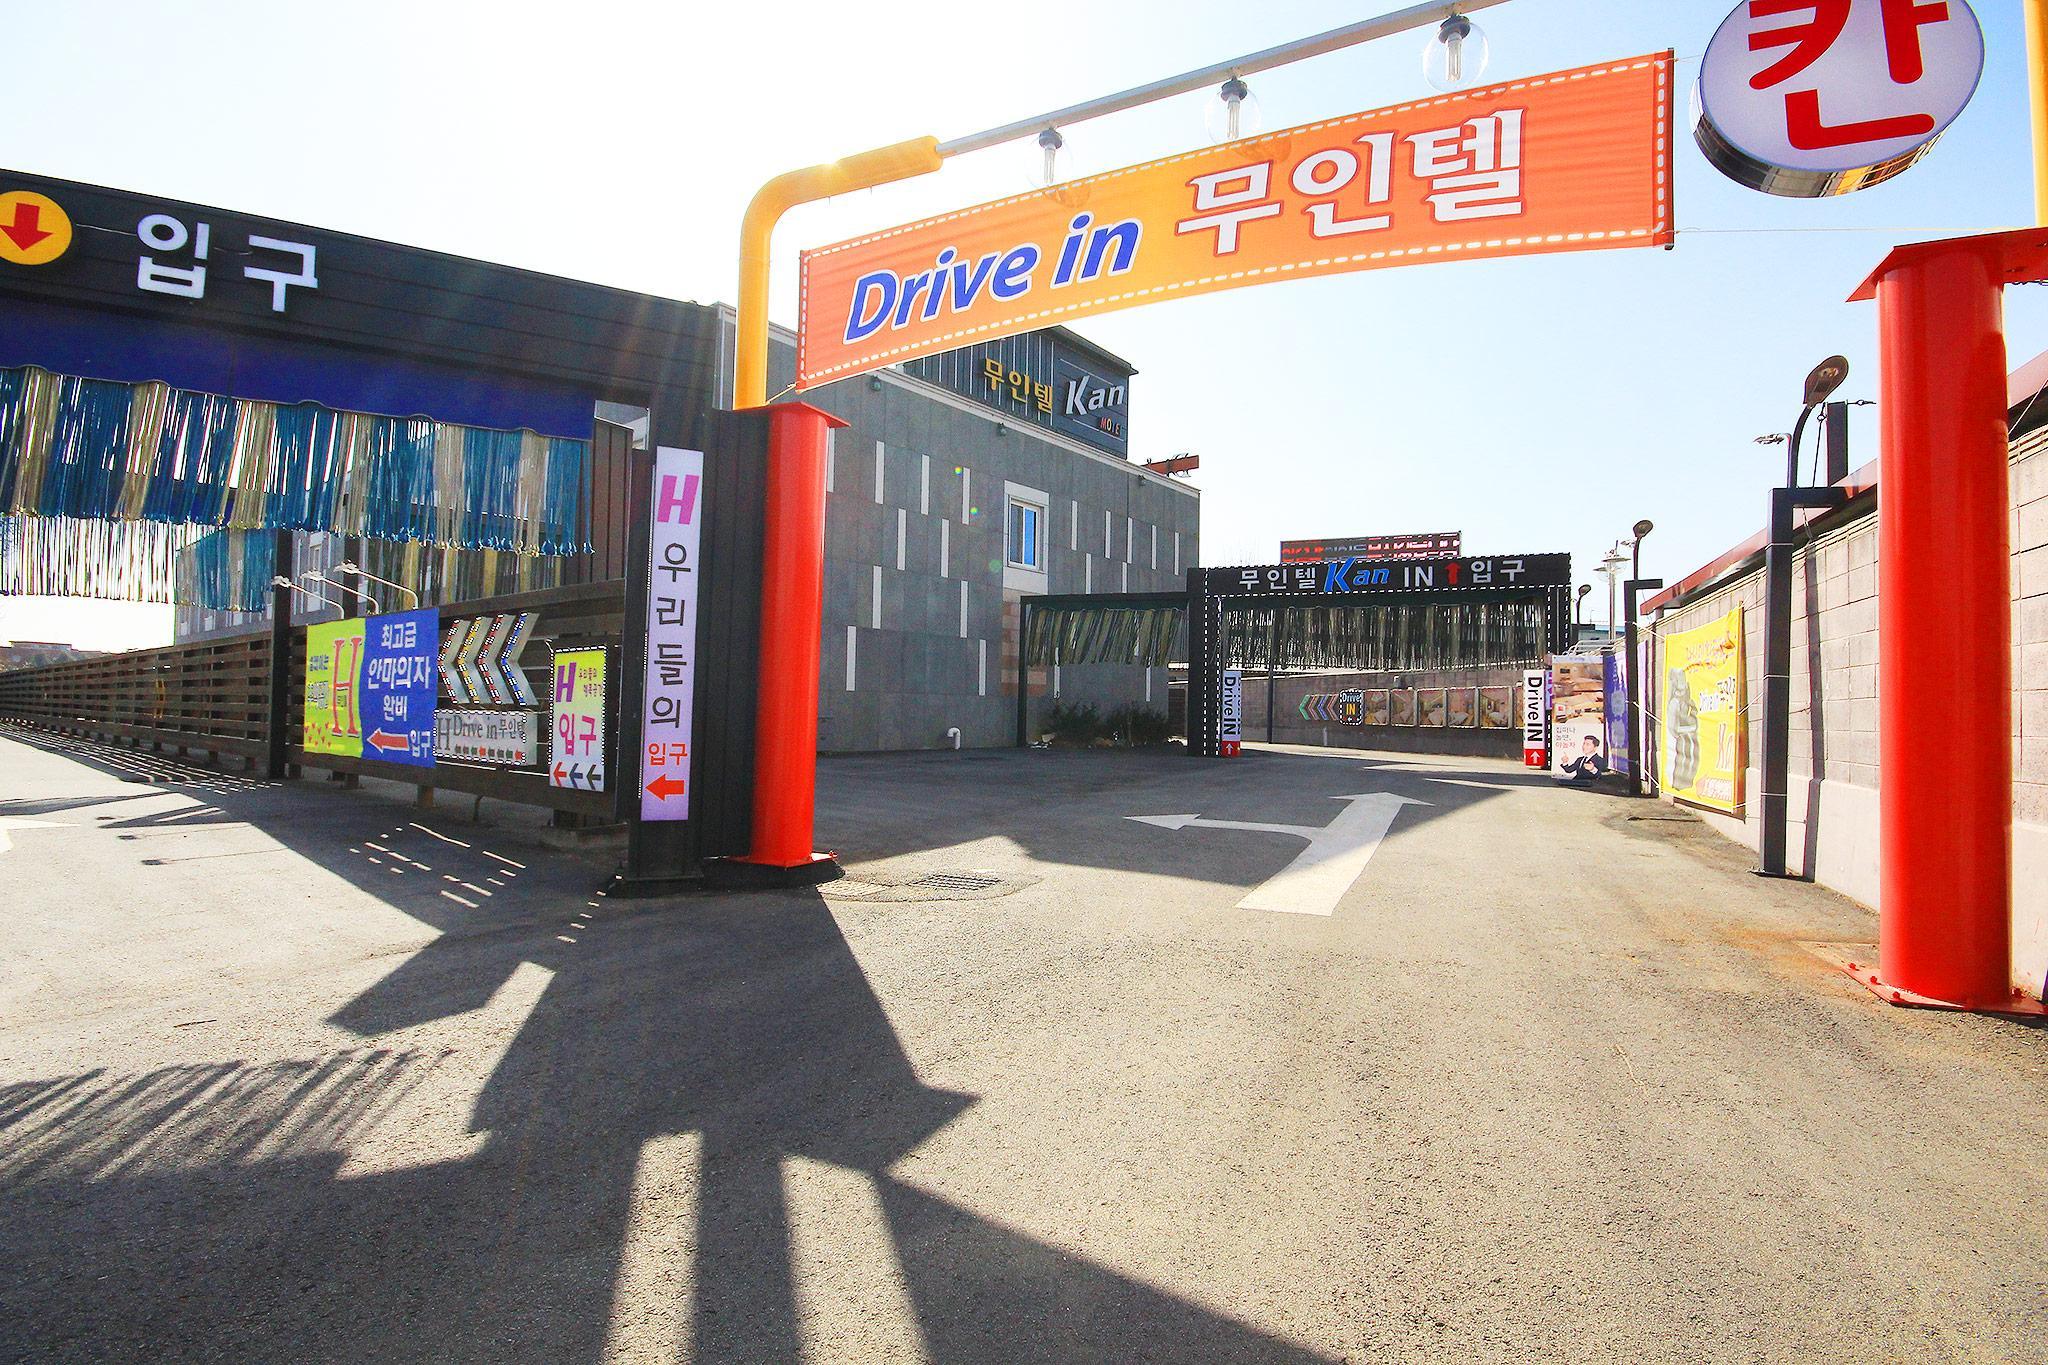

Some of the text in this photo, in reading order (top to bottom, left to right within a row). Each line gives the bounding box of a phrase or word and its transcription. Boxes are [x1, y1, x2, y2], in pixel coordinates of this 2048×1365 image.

[1745, 0, 1951, 154] 칸
[843, 106, 1525, 346] Drive in 무인텔
[136, 213, 319, 313] 입구
[984, 357, 1125, 416] 무인텔 Kan
[657, 474, 699, 525] H
[1239, 556, 1526, 592] 무인텔 Kan IN 입구
[381, 621, 417, 650] 최고급
[650, 542, 692, 729] 우리들의
[332, 636, 363, 738] H
[367, 655, 431, 690] 안마의자
[555, 662, 577, 703] H
[383, 694, 408, 722] 완비
[1342, 692, 1361, 703] Drive
[1346, 703, 1356, 715] IN
[410, 729, 431, 758] 입구
[453, 715, 483, 738] Drive
[486, 716, 497, 739] in
[559, 712, 597, 757] 입구
[648, 742, 688, 767] 입구
